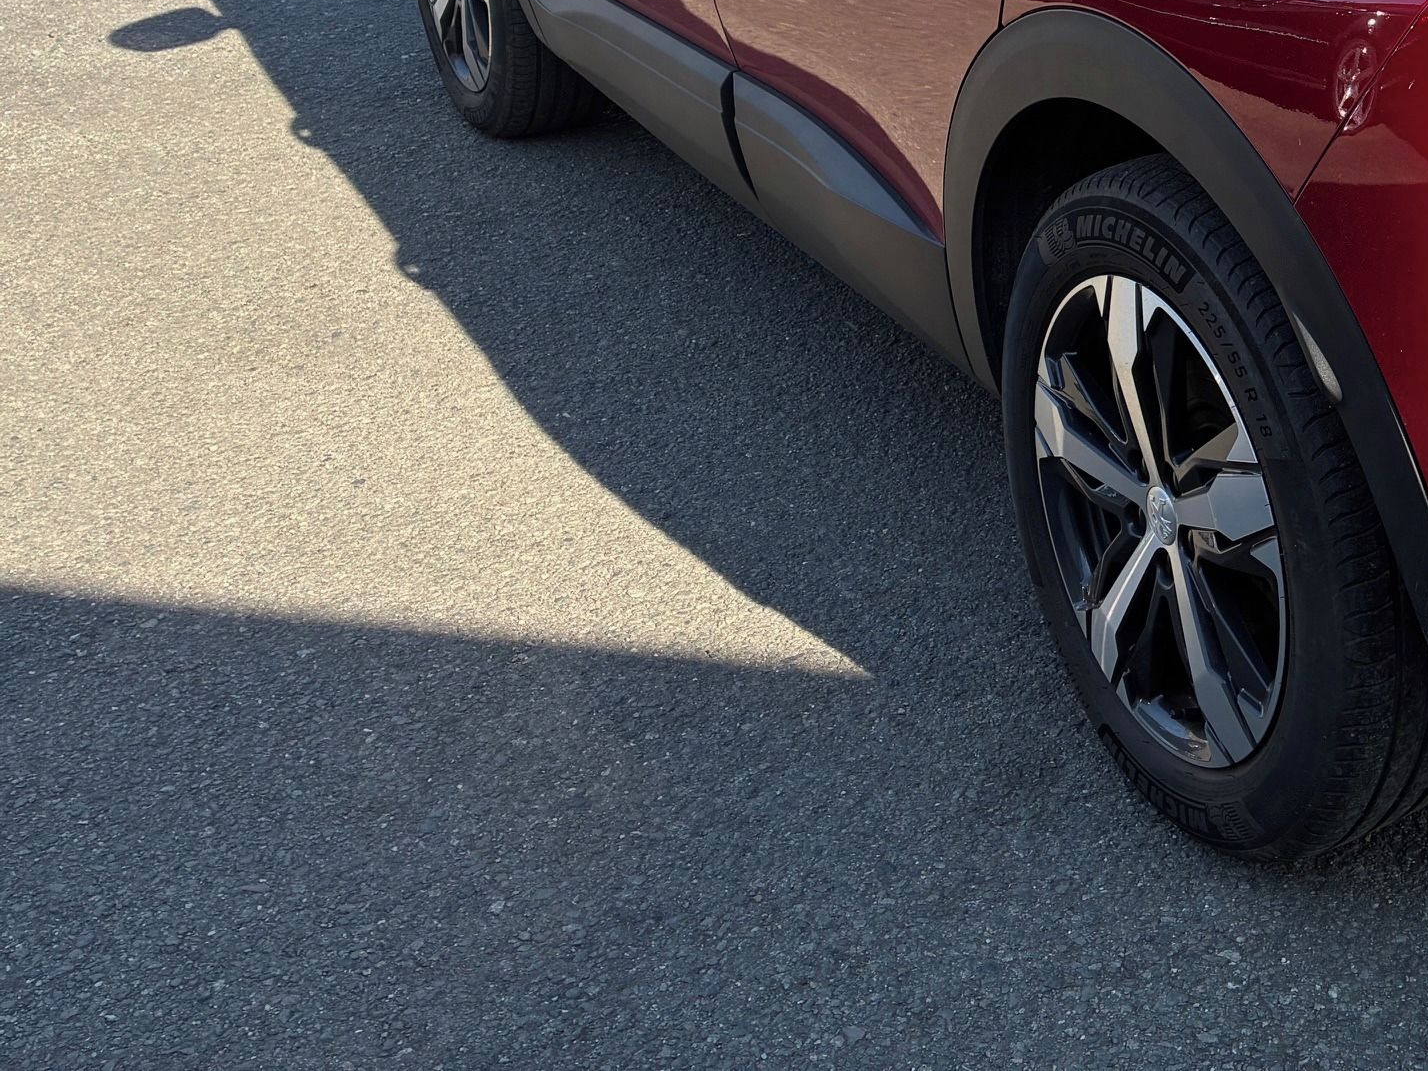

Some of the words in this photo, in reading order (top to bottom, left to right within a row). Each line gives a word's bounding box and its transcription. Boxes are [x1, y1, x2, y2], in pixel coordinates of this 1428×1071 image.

[1076, 214, 1187, 285] MICHELIN
[1197, 301, 1247, 379] 225/55
[1244, 386, 1258, 403] R
[1255, 414, 1273, 438] 18
